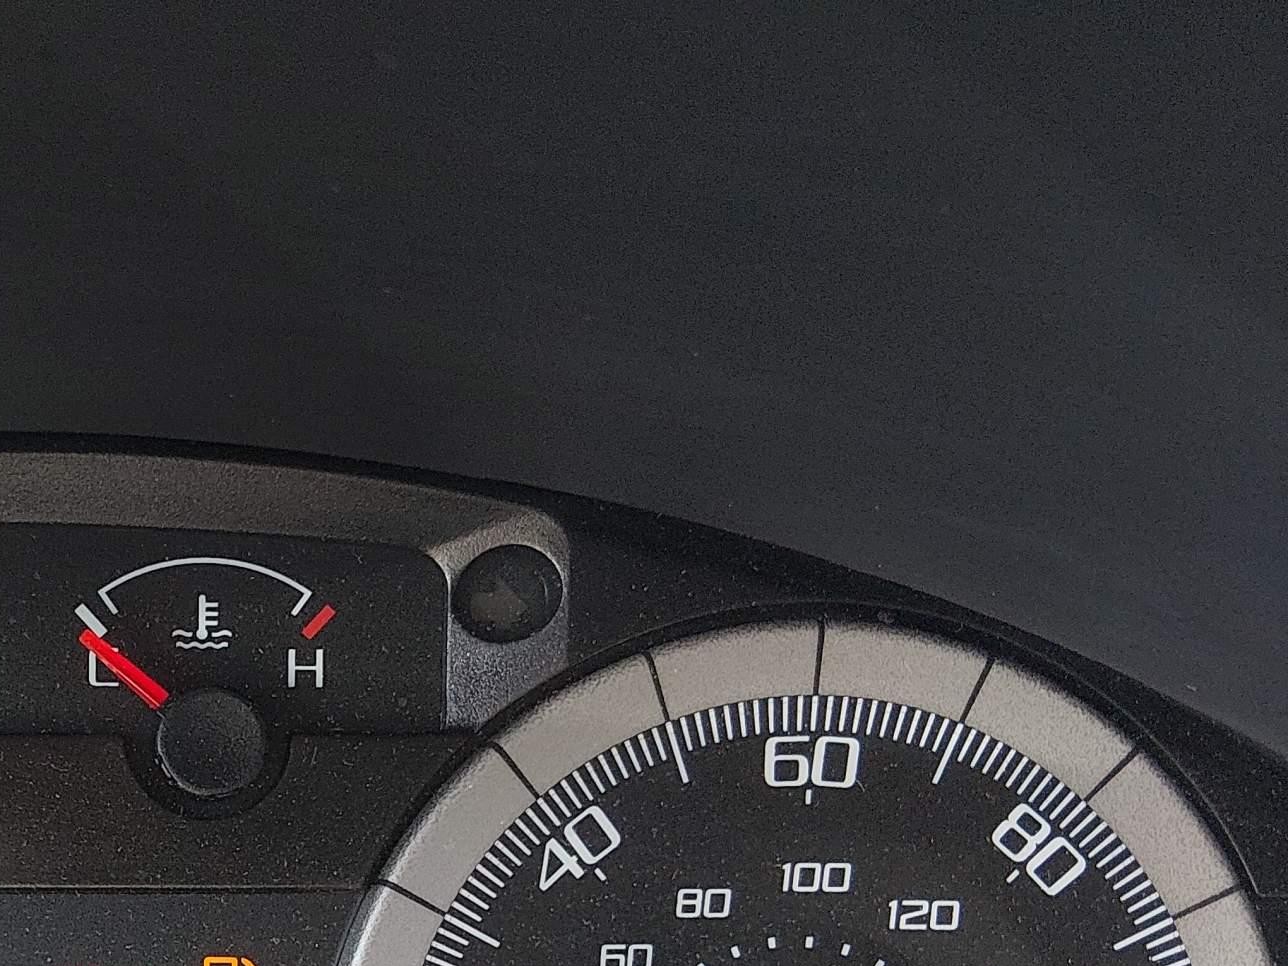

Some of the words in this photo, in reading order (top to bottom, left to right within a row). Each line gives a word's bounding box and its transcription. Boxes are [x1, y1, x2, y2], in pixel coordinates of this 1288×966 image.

[288, 649, 323, 688] H
[764, 736, 861, 788] 60
[538, 805, 621, 891] 40
[991, 803, 1087, 896] 80
[780, 862, 851, 893] 100
[676, 889, 732, 919] 80
[887, 900, 960, 931] 120
